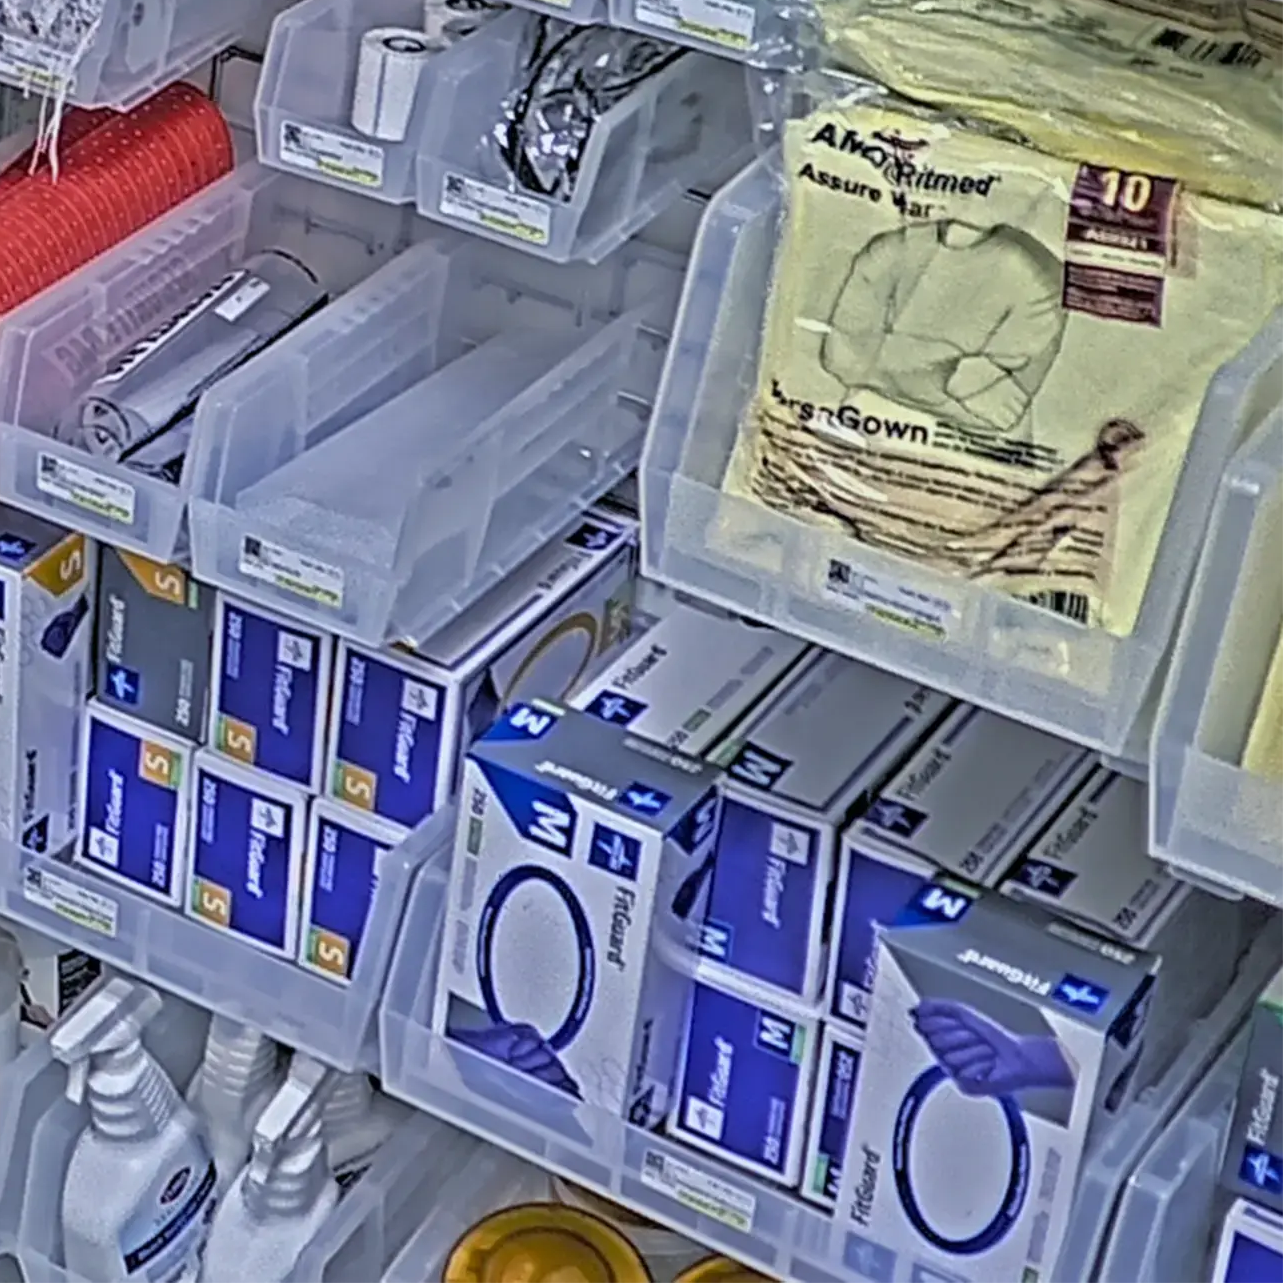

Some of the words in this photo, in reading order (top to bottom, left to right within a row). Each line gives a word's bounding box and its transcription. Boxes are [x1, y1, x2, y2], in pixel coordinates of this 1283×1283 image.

[797, 162, 883, 204] Assure
[1099, 169, 1153, 213] 10
[59, 549, 82, 581] S
[154, 573, 182, 599] S
[105, 594, 127, 664] FitGuard
[271, 664, 295, 737] FitGuard
[508, 706, 553, 736] M
[228, 729, 254, 755] S
[393, 712, 418, 784] FitGuard
[144, 751, 171, 776] S
[732, 748, 785, 787] M
[103, 768, 126, 836] FitGuard
[346, 774, 372, 799] S
[528, 799, 572, 850] M
[246, 830, 269, 900] FitGuard
[202, 890, 228, 916] S
[920, 888, 967, 918] M
[606, 884, 638, 974] FitGuard
[698, 922, 729, 958] M
[319, 940, 346, 966] S
[759, 1017, 793, 1051] M
[1246, 1068, 1280, 1145] FitGuard
[849, 1144, 882, 1227] FitGuard
